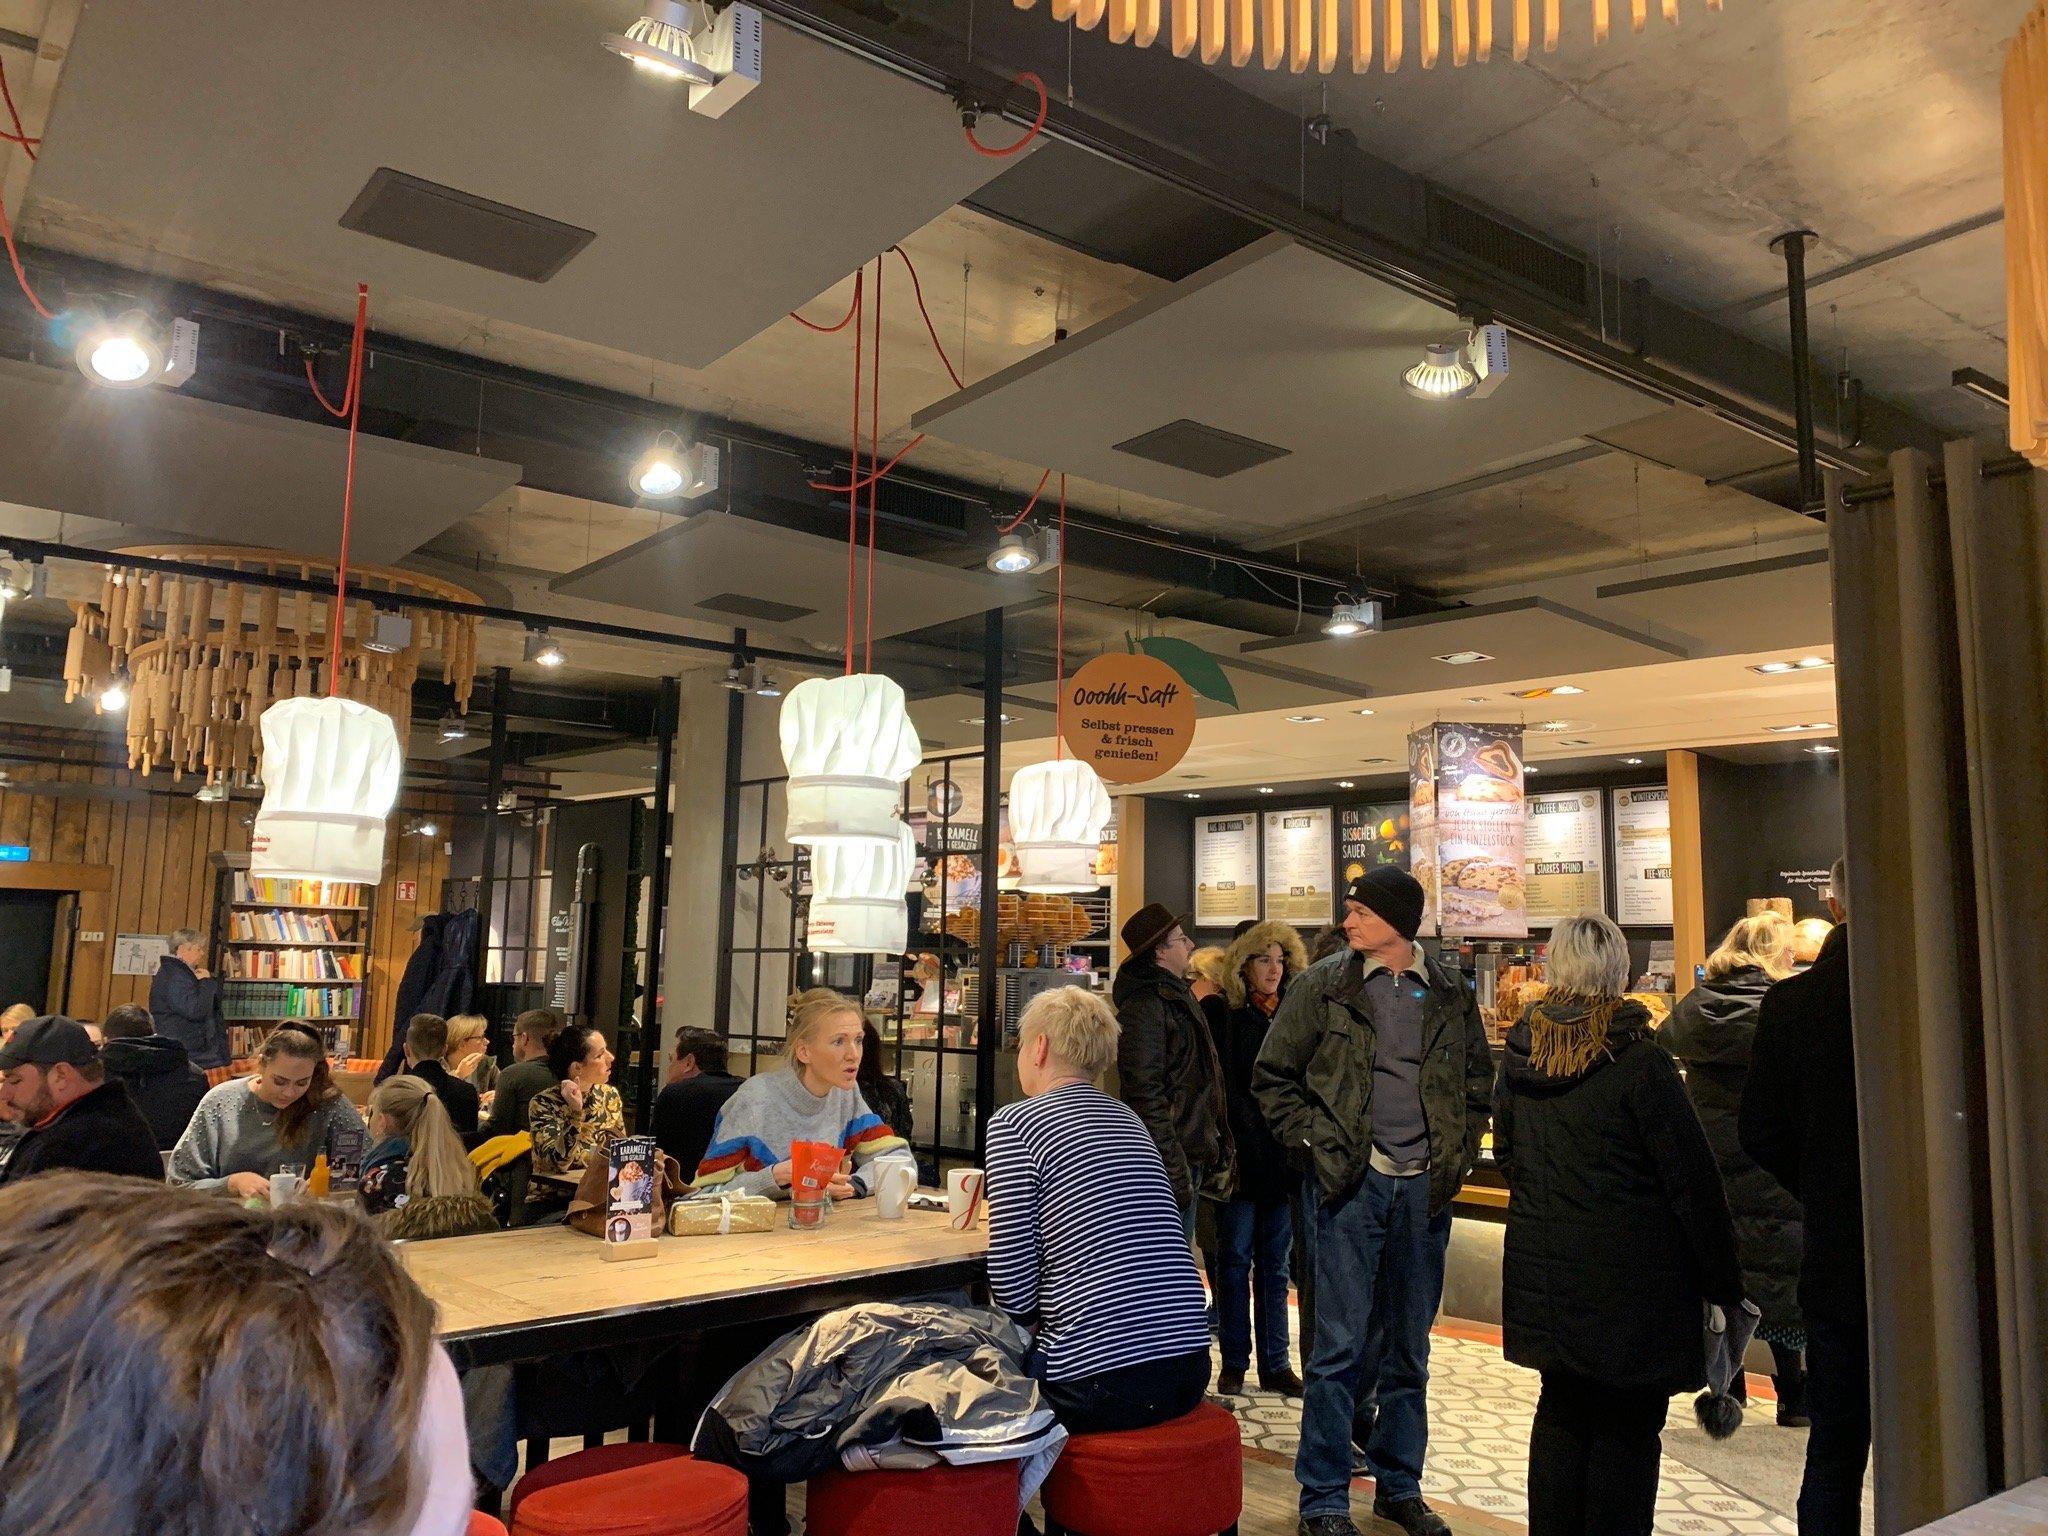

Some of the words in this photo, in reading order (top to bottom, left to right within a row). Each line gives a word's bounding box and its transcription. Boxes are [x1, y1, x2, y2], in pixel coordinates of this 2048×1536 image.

[1073, 682, 1179, 708] Ooohh-Saft
[1081, 718, 1121, 732] Selbst
[1124, 724, 1175, 736] pressen
[1101, 734, 1112, 745] &
[1115, 734, 1153, 748] frisch
[1094, 748, 1158, 762] genießen!
[1535, 803, 1557, 814] KAFFEE
[1342, 810, 1359, 825] KEIN
[936, 827, 979, 842] KRAMELL
[1342, 826, 1377, 842] BISSCHEN
[1342, 843, 1366, 859] SAUER
[1536, 862, 1560, 875] STARKES
[1561, 861, 1581, 873] PFUND
[620, 1145, 646, 1155] KARAMELL
